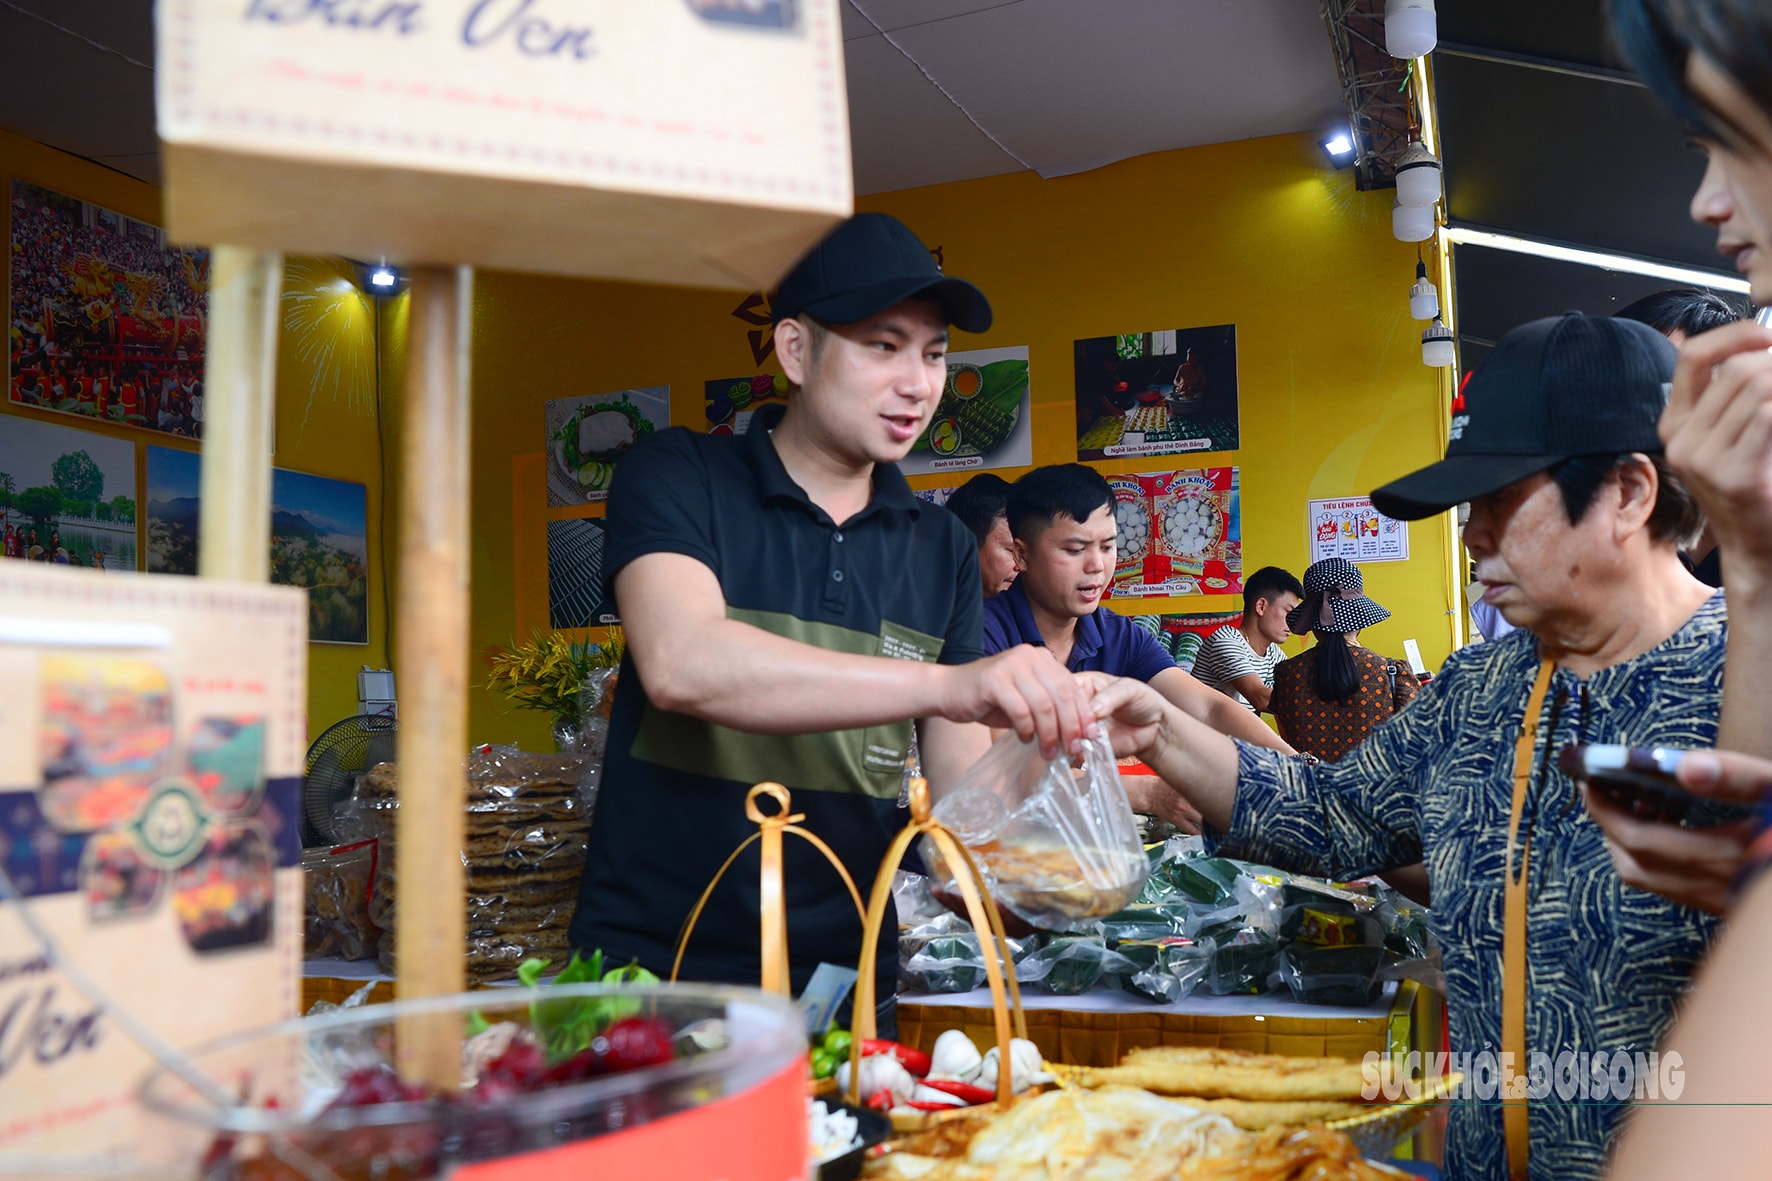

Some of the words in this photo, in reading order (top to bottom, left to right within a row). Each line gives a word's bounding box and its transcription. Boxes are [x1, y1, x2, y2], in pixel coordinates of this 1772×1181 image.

[1110, 446, 1126, 454] Nghề
[1126, 445, 1137, 453] làm
[1138, 444, 1152, 452] bánh
[934, 460, 948, 468] Bánh
[1133, 583, 1148, 593] Bánh
[1148, 583, 1165, 592] khoai
[1165, 582, 1175, 592] Thị
